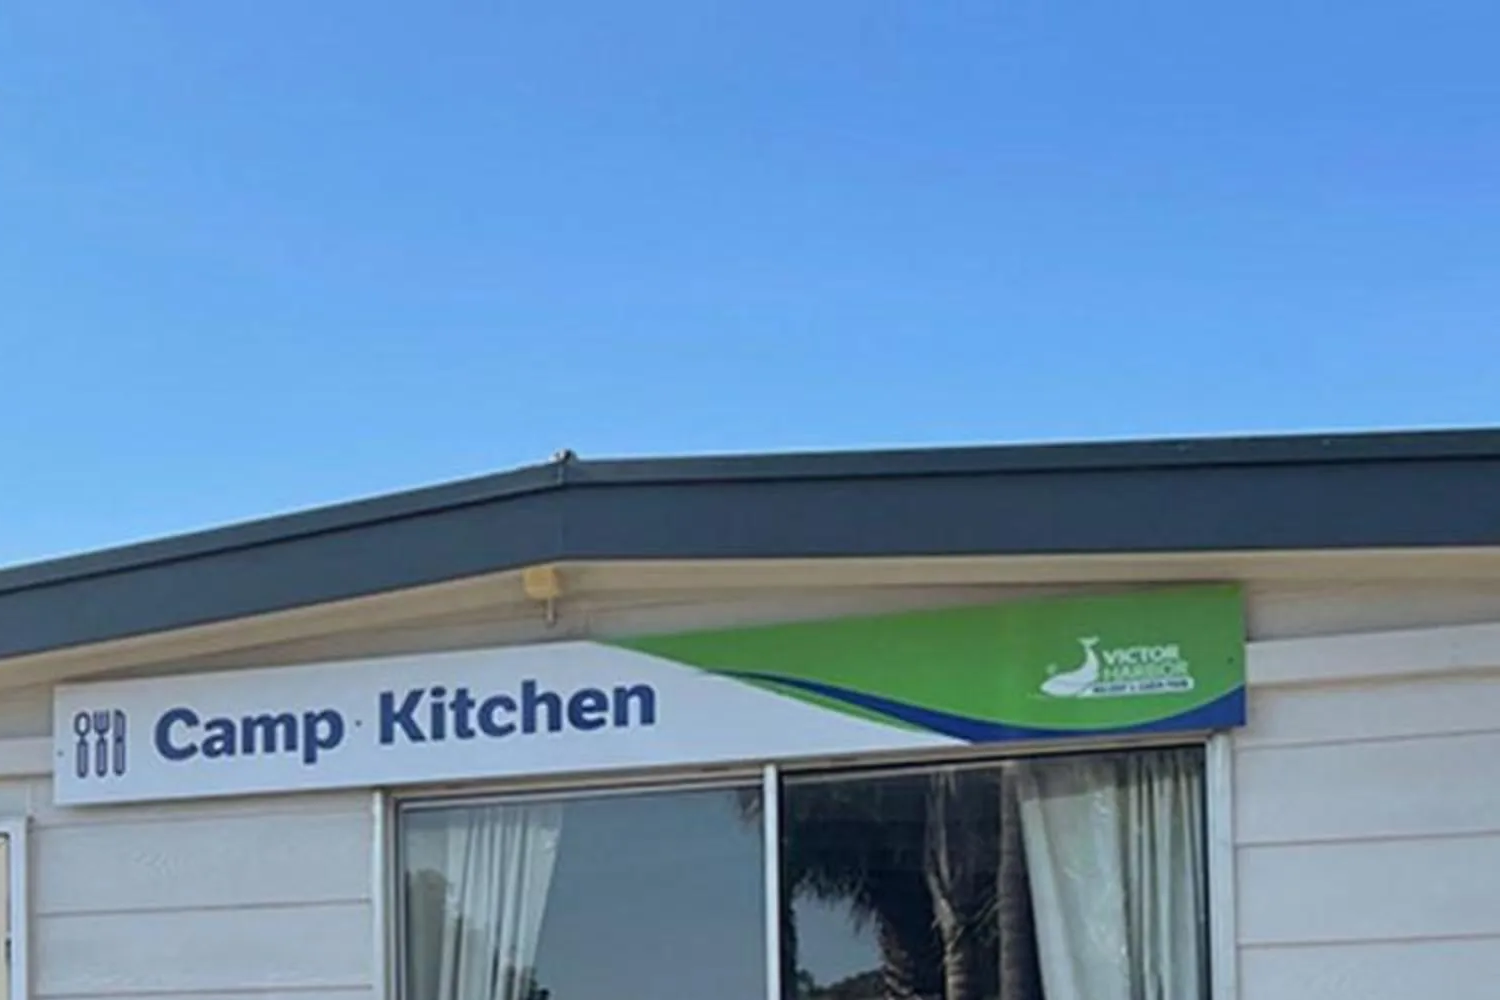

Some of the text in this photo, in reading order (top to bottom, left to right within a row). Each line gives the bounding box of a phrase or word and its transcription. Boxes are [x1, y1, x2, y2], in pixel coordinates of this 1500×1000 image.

[1102, 645, 1179, 665] VICTOR
[155, 679, 657, 764] Camp Kitchen
